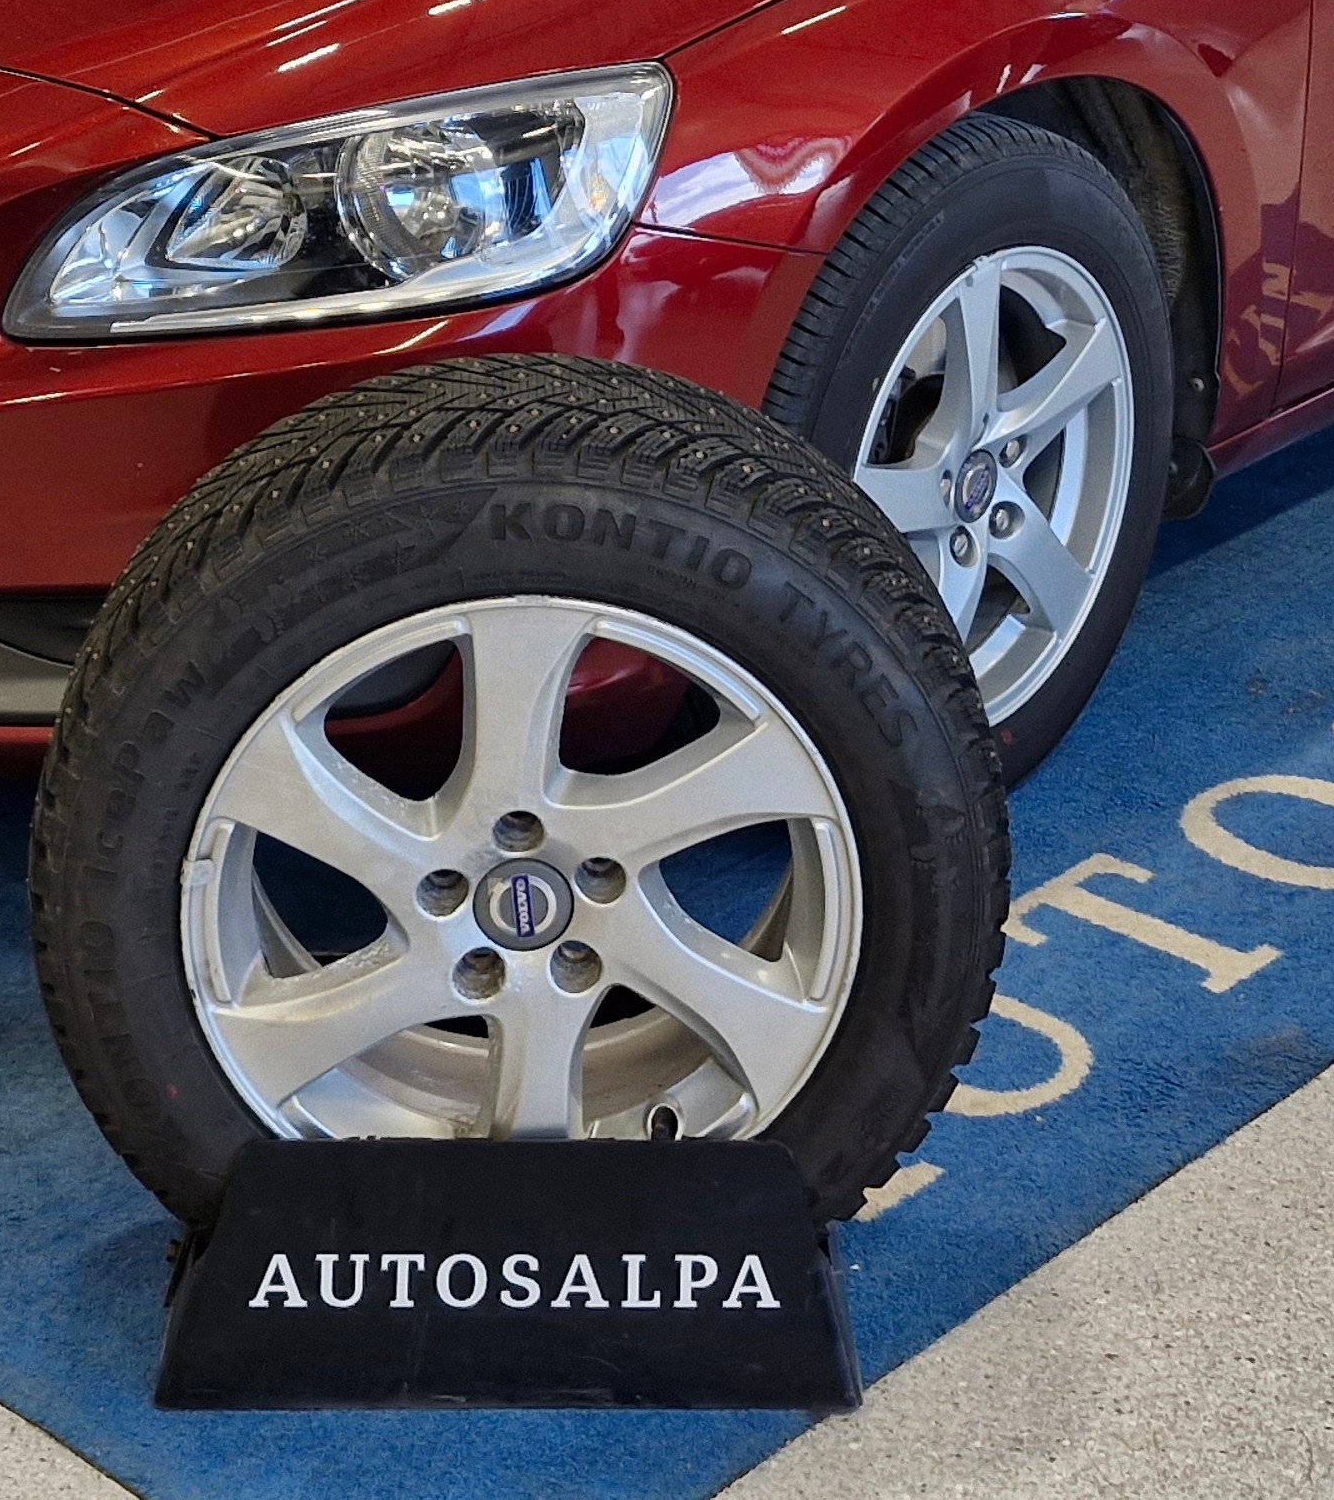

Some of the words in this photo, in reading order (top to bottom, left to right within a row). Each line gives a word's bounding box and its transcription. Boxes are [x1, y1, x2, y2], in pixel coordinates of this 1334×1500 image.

[489, 502, 753, 591] KONTIO
[777, 581, 918, 748] TYRES
[516, 878, 531, 936] VOLVO
[248, 1254, 781, 1309] AUTOSALPA
